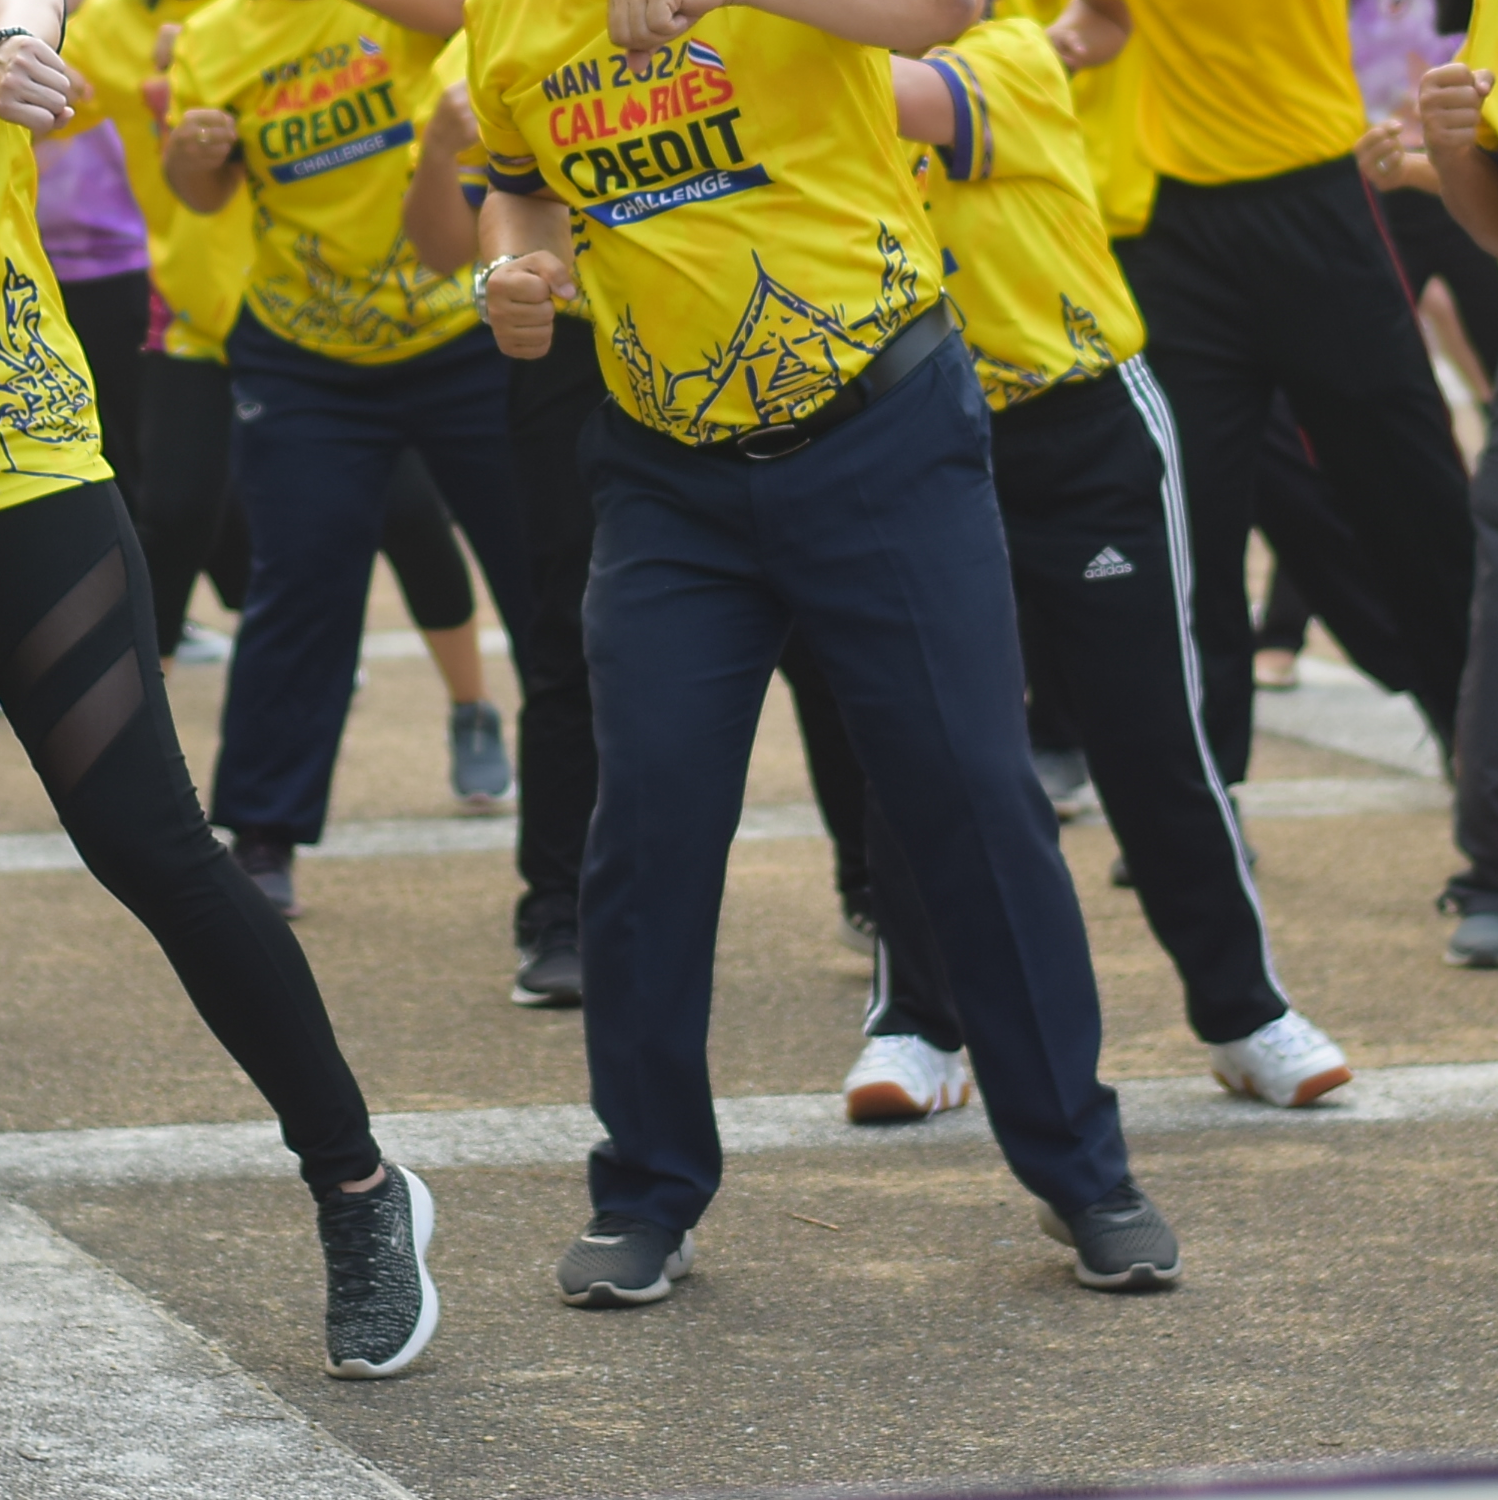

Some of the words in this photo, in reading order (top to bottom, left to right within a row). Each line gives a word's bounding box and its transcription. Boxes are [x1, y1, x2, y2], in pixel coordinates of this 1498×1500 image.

[308, 43, 351, 74] 202
[541, 59, 602, 102] NAN
[259, 80, 398, 160] CREDIT
[293, 135, 386, 176] CHALLENGE
[559, 106, 745, 199] CREDIT
[611, 171, 732, 222] CHALLENGE
[1084, 562, 1133, 579] adidas
